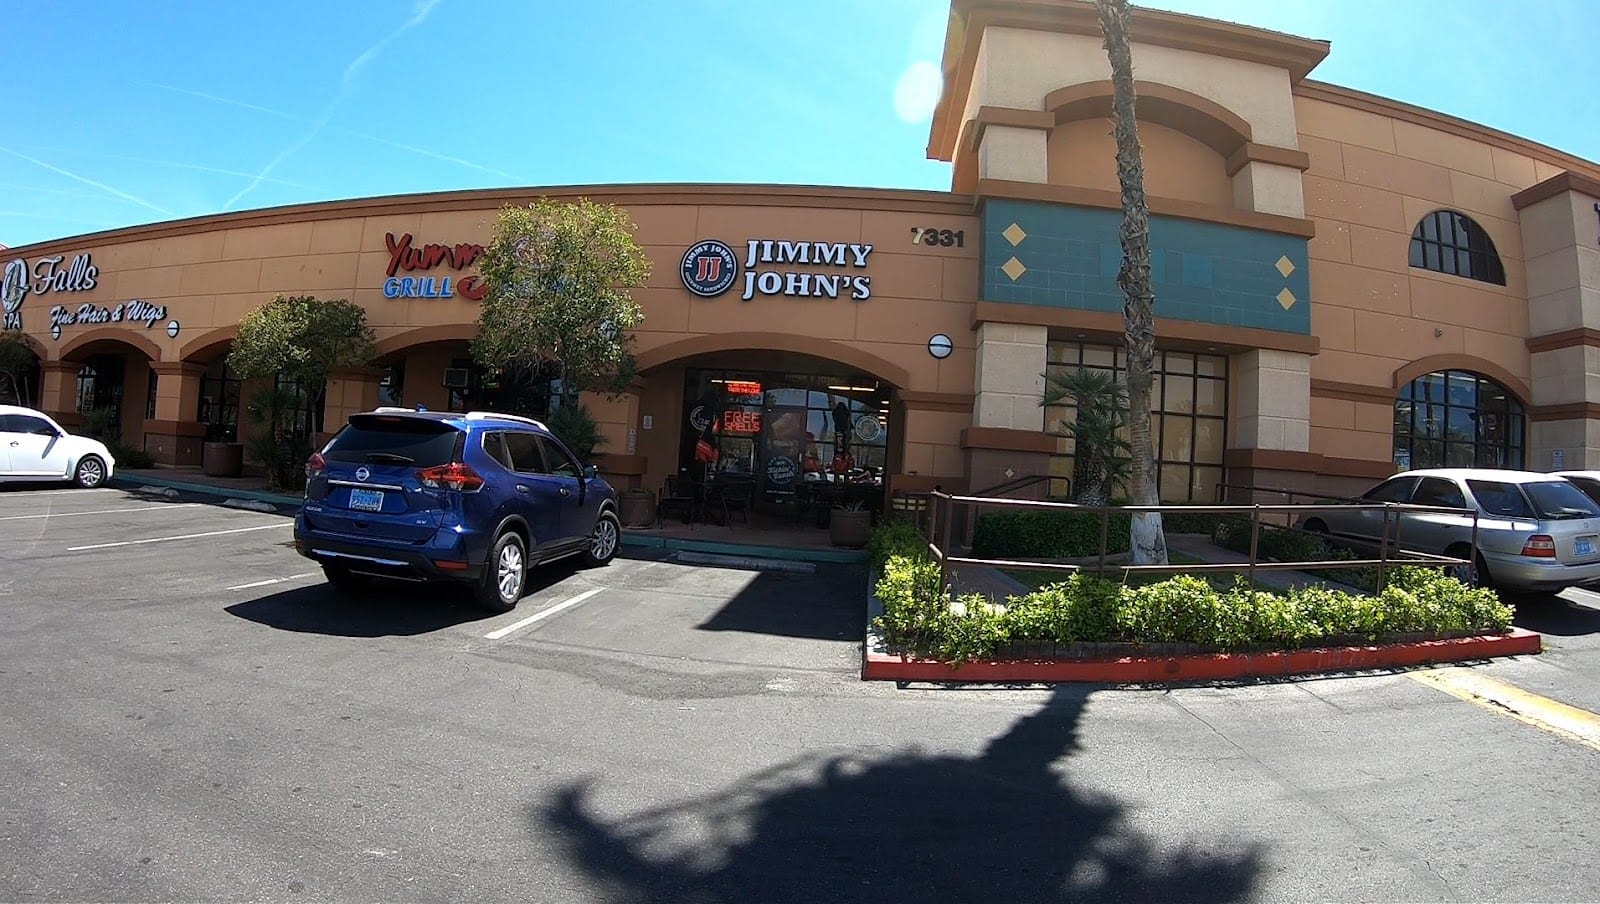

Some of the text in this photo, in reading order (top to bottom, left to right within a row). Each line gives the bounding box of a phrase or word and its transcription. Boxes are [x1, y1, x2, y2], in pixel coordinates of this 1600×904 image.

[911, 227, 964, 247] 7331
[385, 232, 488, 277] Yumm
[685, 245, 709, 268] JIMMY
[745, 239, 873, 267] JIMMY
[33, 253, 98, 295] Falls
[695, 256, 722, 282] JJ
[383, 276, 453, 298] GRILL
[742, 271, 871, 300] JOHN'S
[3, 312, 21, 329] SPA
[50, 299, 167, 328] Fine Hair & Wigs
[724, 411, 761, 424] FREE
